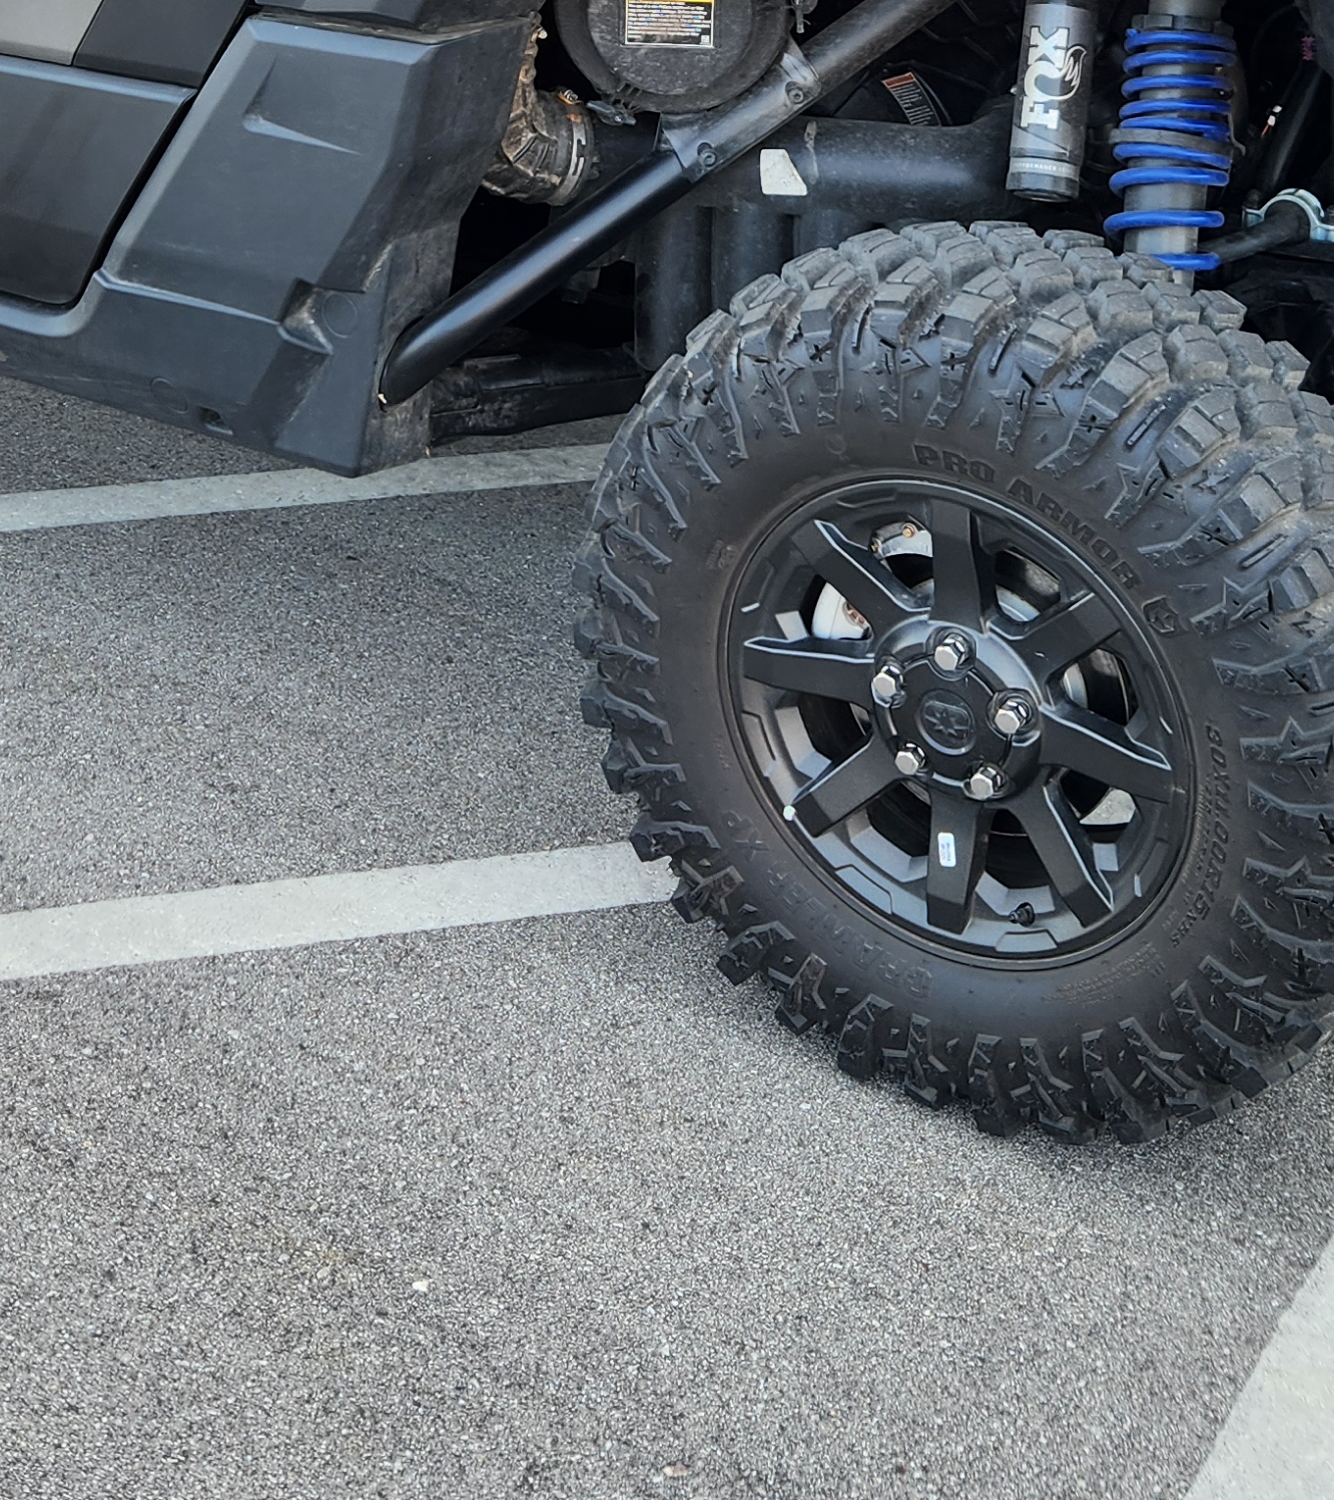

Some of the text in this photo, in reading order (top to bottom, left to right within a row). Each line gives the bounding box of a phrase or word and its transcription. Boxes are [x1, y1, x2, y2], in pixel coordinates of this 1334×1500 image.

[1020, 26, 1077, 130] FOX
[913, 443, 1141, 590] PRO ARMOR
